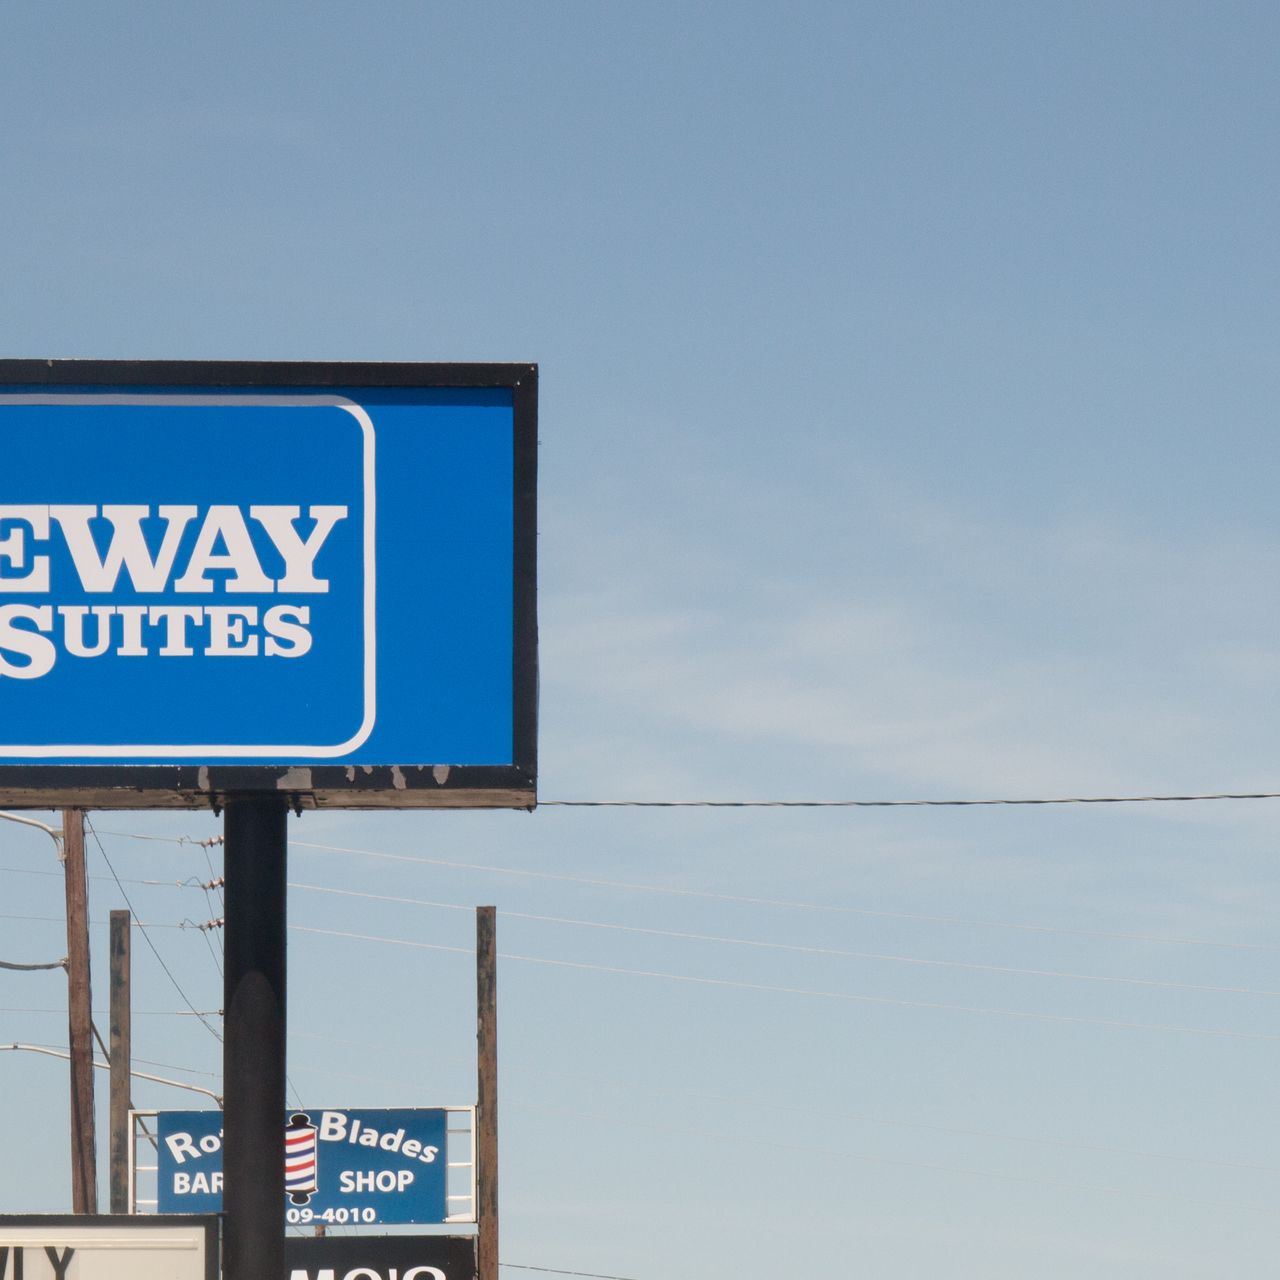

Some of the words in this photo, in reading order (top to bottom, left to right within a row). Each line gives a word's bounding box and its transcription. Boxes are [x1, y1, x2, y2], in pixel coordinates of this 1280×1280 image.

[319, 1111, 439, 1163] Blades
[173, 1172, 224, 1194] BAR
[339, 1170, 415, 1193] SHOP
[286, 1207, 376, 1224] 09-4010
